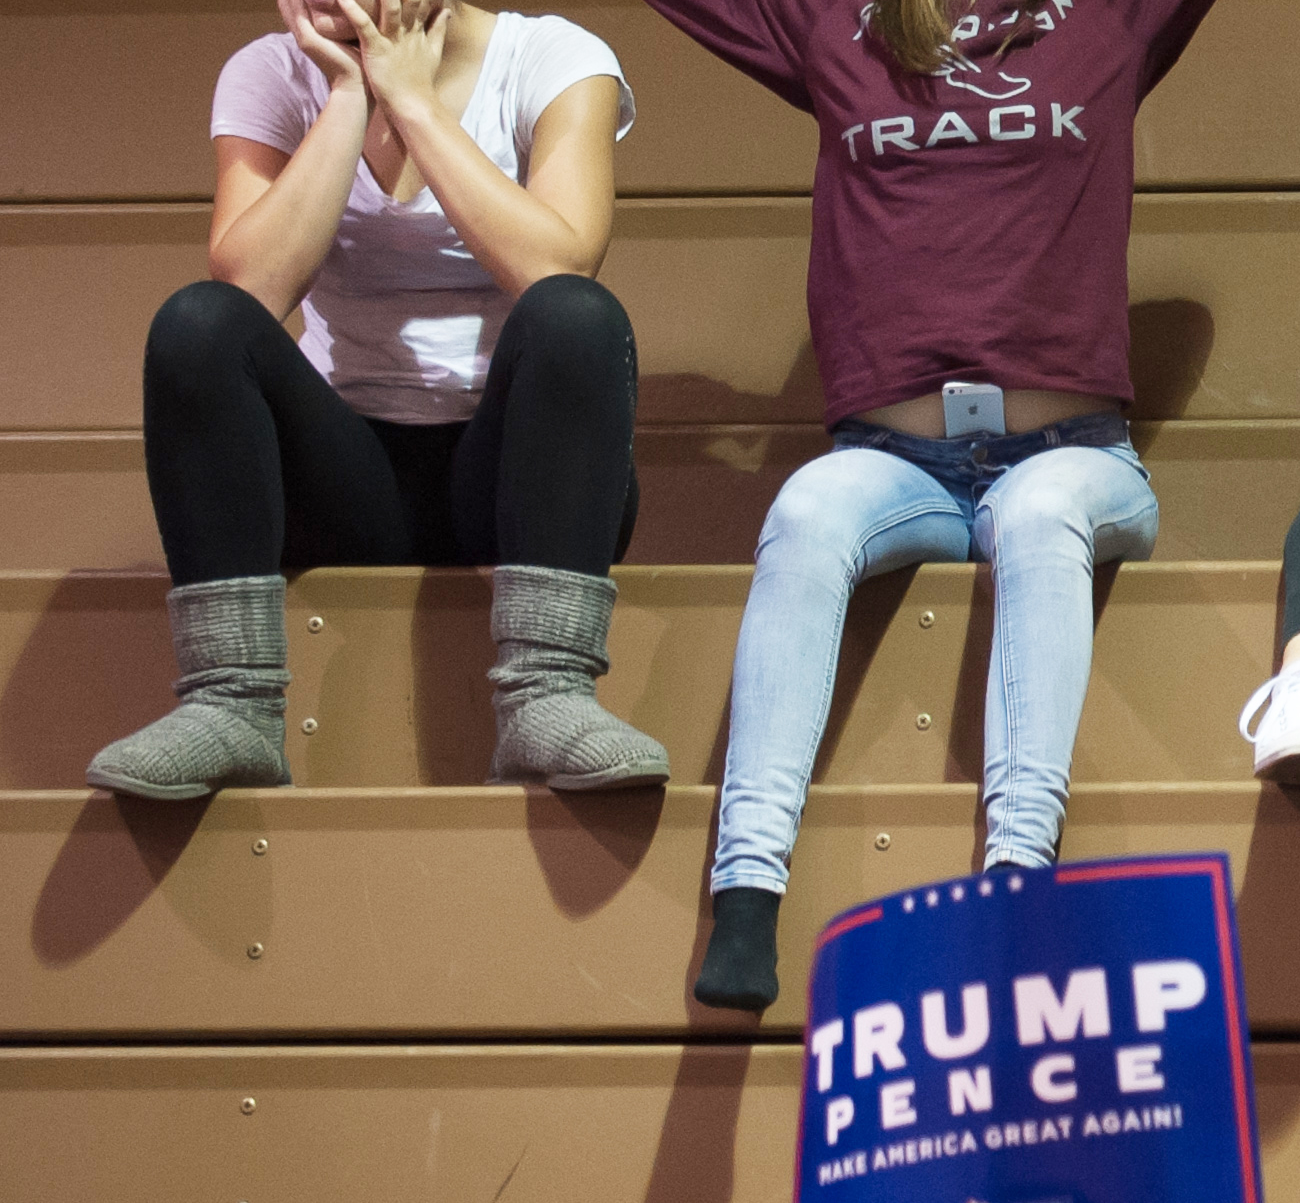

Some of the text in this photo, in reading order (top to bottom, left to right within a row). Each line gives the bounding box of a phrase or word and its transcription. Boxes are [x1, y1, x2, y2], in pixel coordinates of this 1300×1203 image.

[841, 102, 1087, 163] TRACK
[809, 958, 1208, 1094] TRUMP
[824, 1043, 1166, 1147] PENCE
[818, 1103, 1184, 1186] MAKE AMERICA GREAT AGAIN!
